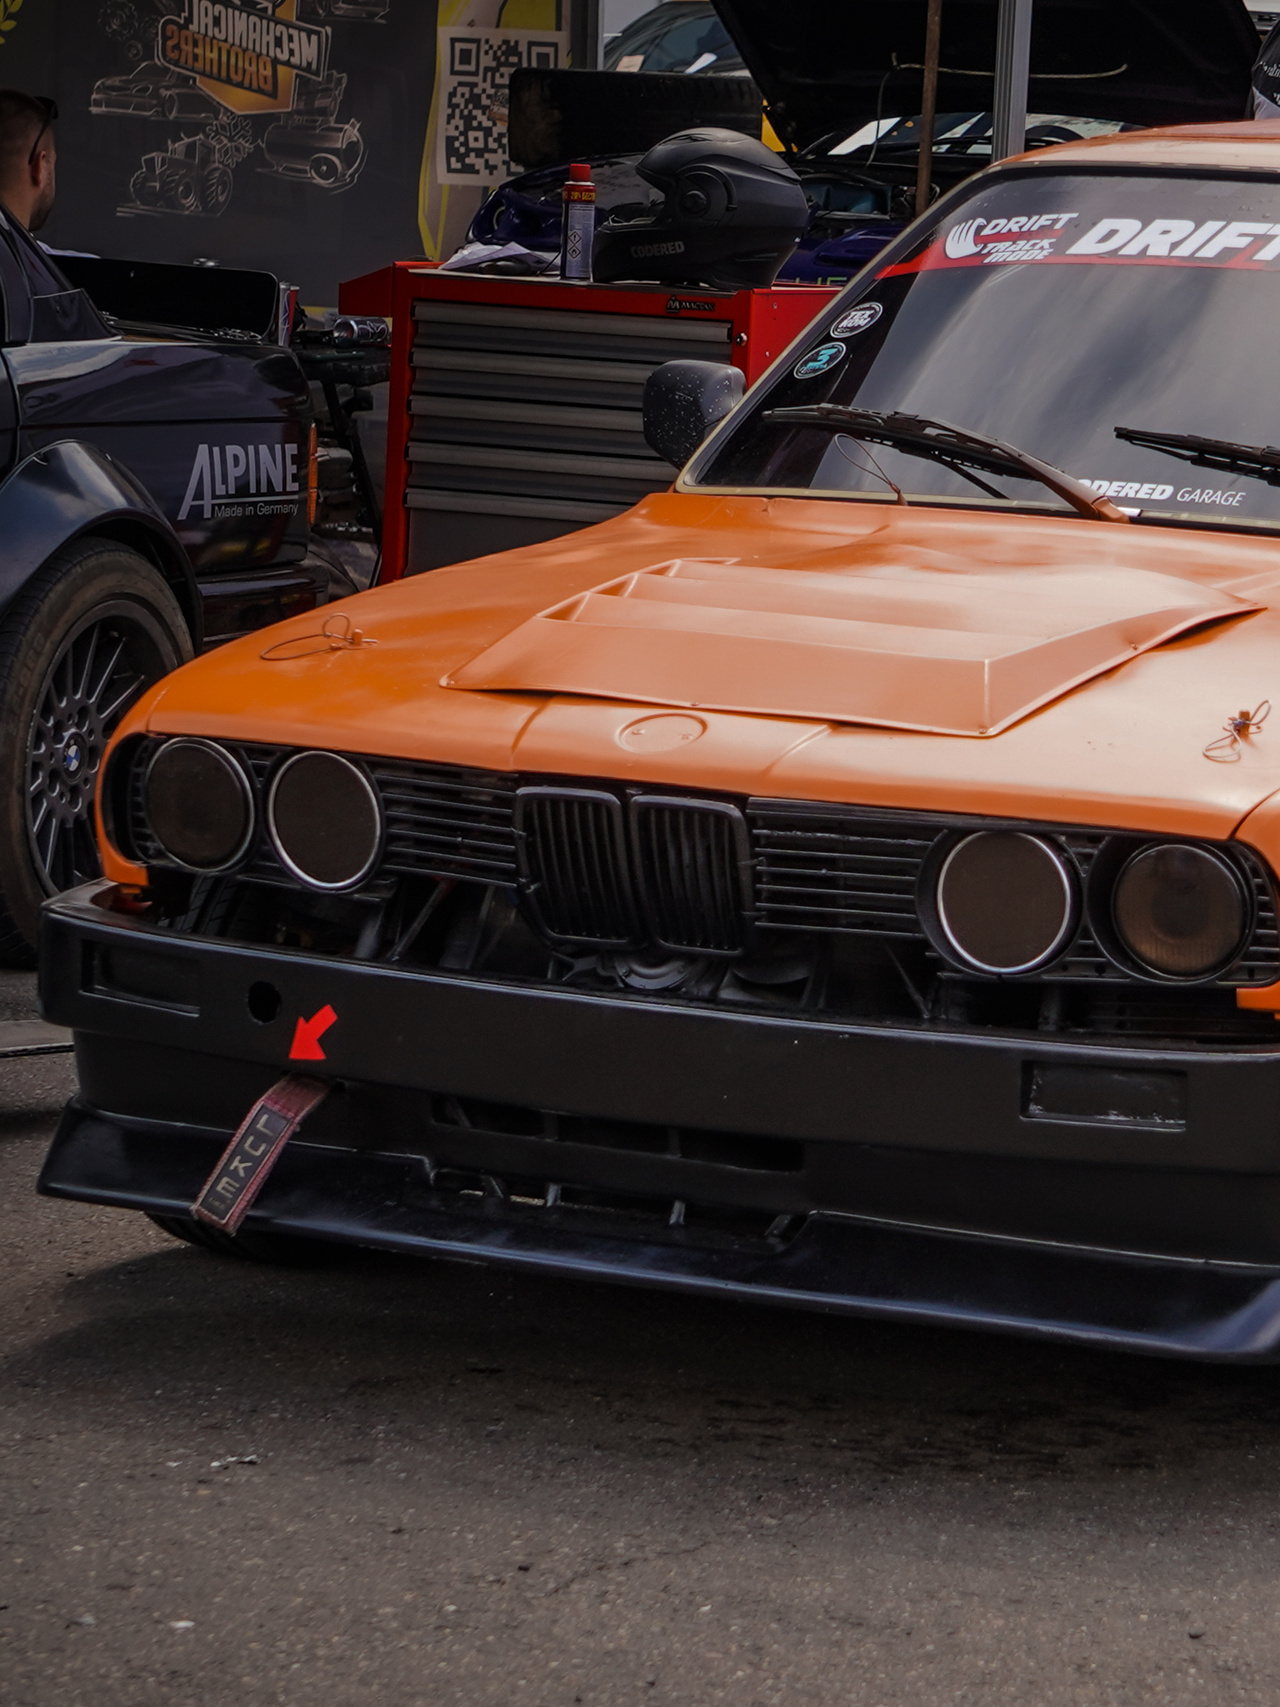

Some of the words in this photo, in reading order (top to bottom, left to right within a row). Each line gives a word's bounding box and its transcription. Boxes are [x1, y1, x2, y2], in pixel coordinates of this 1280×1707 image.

[980, 213, 1079, 236] DRIFT
[631, 241, 685, 258] CODERED
[177, 443, 299, 520] ALPINE
[1077, 479, 1174, 500] DERED
[1176, 487, 1246, 506] GARAGE
[214, 506, 243, 518] Made
[245, 504, 254, 515] in
[257, 503, 299, 516] Germany
